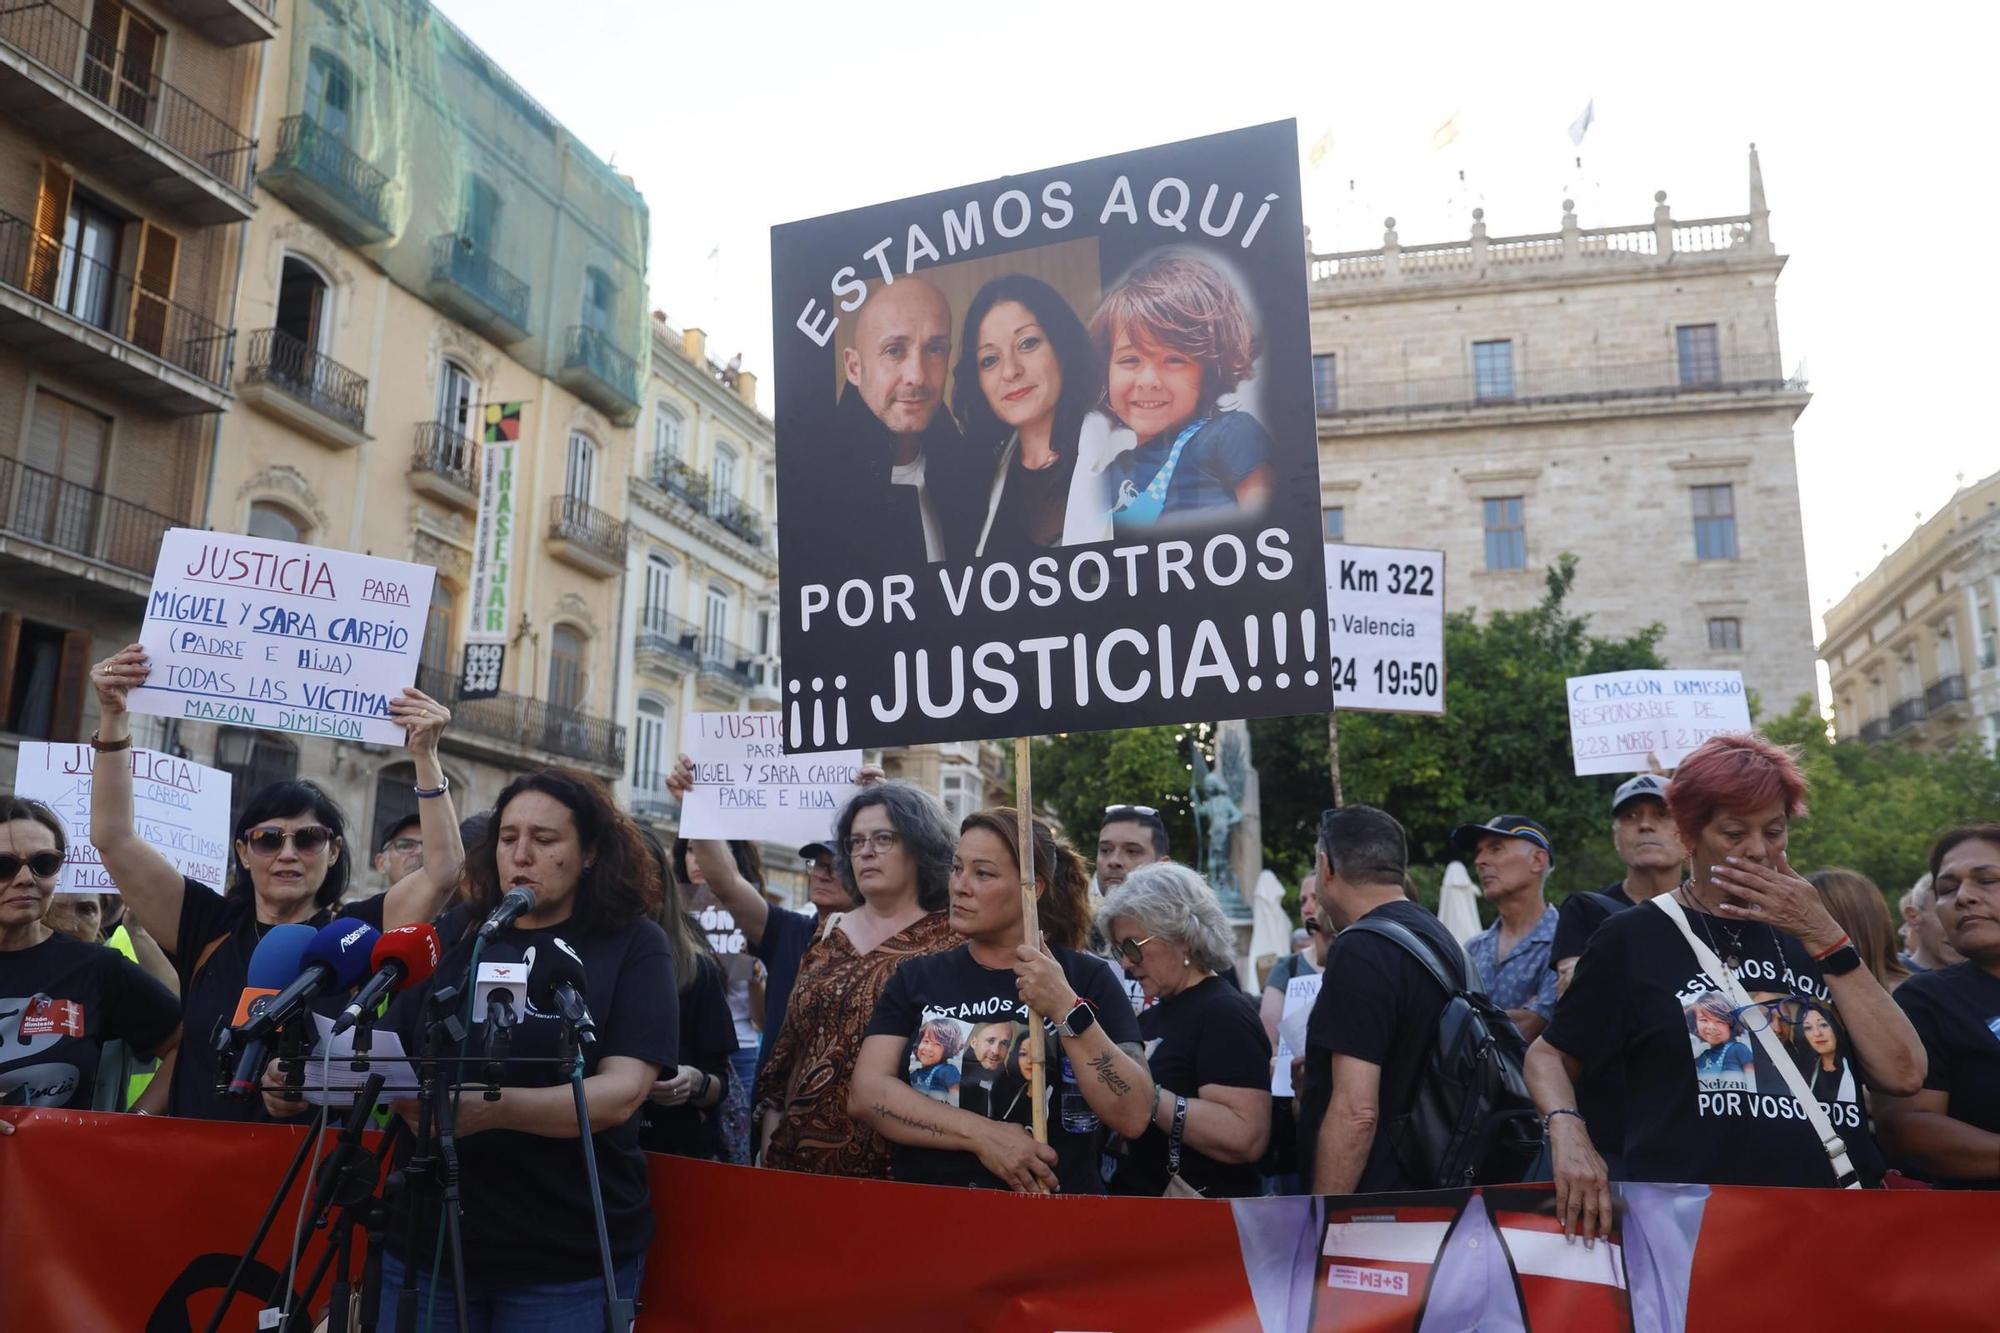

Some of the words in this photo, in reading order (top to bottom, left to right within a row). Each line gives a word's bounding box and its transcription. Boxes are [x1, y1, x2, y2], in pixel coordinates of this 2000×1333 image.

[796, 179, 1074, 348] ESTAMOS
[1100, 175, 1280, 249] AQUÍ
[186, 545, 337, 598] JUSTICIA
[362, 578, 409, 604] PARA
[801, 574, 916, 632] POR
[939, 527, 1294, 617] VOSOTROS
[1340, 559, 1378, 592] Km
[1387, 563, 1434, 596] 322
[150, 586, 228, 625] MIGUEL
[239, 603, 252, 626] Y
[253, 605, 317, 638] SARA
[328, 618, 408, 650] CARPIO
[1342, 613, 1415, 637] Valencia
[169, 627, 247, 657] (PADRE
[265, 646, 278, 662] E
[298, 648, 353, 676] HIJA)
[870, 608, 1320, 724] JUSTICIA!!!
[166, 664, 236, 694] TODAS
[249, 676, 288, 701] LAS
[1373, 659, 1438, 697] 19:50
[184, 699, 256, 723] MAZÓN
[1693, 701, 1716, 717] DE
[1576, 735, 1611, 756] 228
[743, 763, 754, 783] Y
[758, 764, 800, 783] SARA
[808, 764, 858, 784] CARPIO
[147, 783, 190, 808] CARPIO
[719, 787, 767, 808] PADRE
[779, 788, 789, 806] E
[800, 789, 836, 808] HIJA
[186, 861, 222, 882] MADRE
[426, 935, 438, 967] rne
[1781, 967, 1832, 1004] AQU
[1698, 1093, 1742, 1117] POR
[1747, 1094, 1860, 1128] VOSOROS
[1359, 1271, 1404, 1291] S+EM
